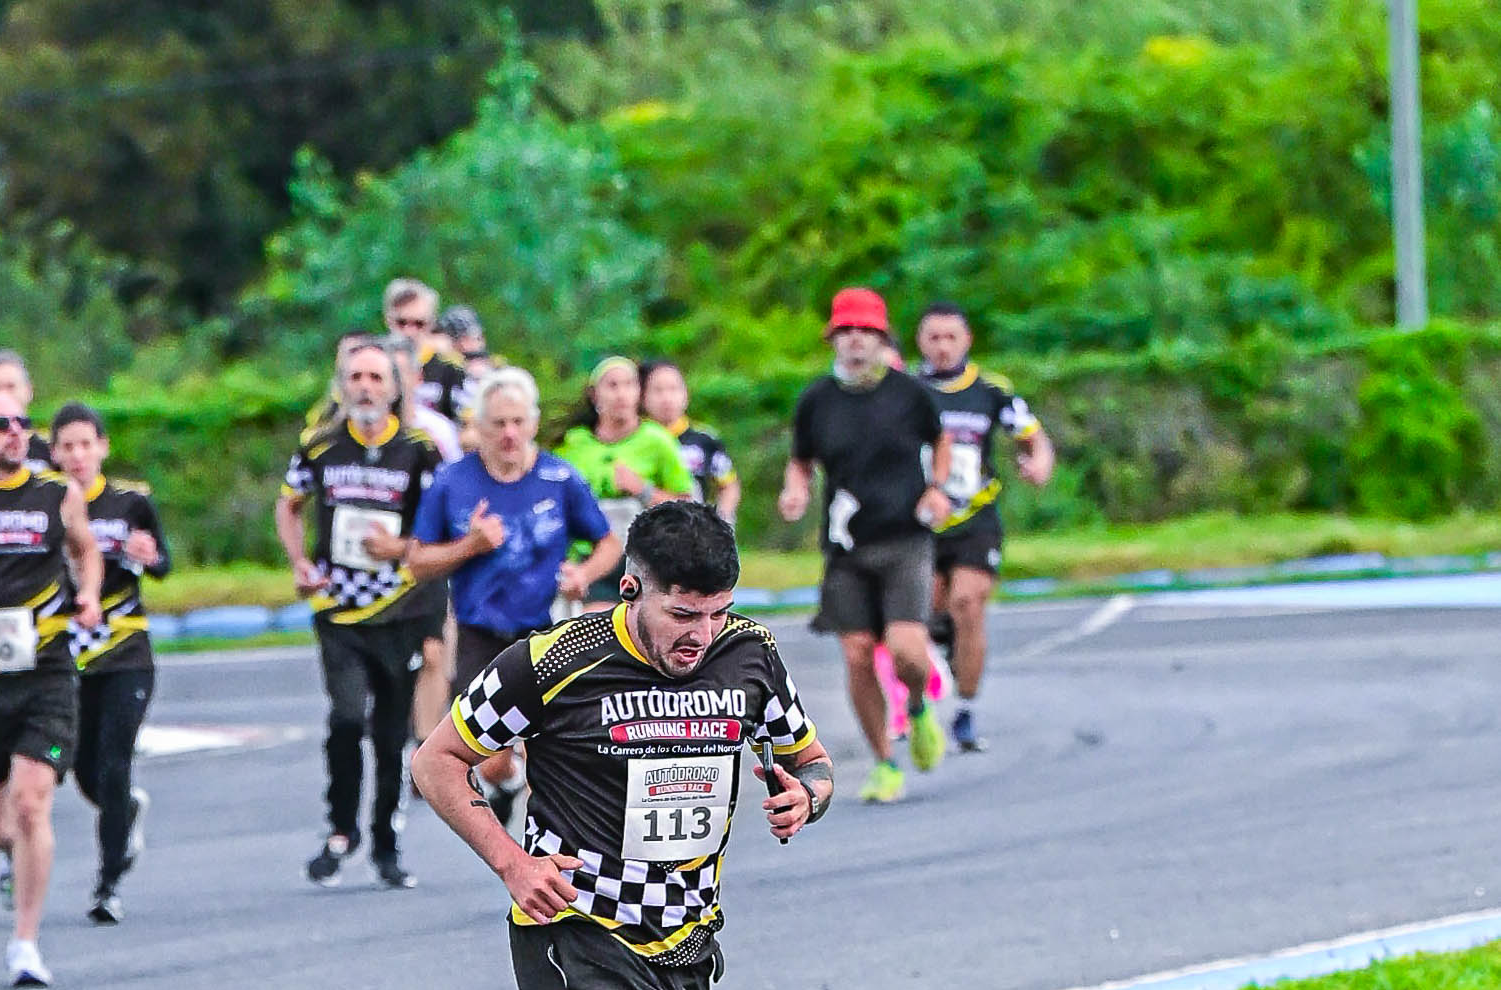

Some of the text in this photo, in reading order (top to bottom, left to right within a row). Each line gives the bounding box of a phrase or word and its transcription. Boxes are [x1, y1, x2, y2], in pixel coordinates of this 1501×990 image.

[601, 686, 747, 726] AUTÓDROMO
[625, 721, 728, 741] RUNNING RACE
[598, 744, 608, 755] La
[610, 745, 644, 756] Carrera
[644, 745, 656, 754] de
[657, 744, 669, 754] los
[671, 744, 701, 754] Clubes
[702, 743, 716, 754] del
[645, 763, 720, 786] AUTÓDROMO
[687, 783, 705, 793] RACE
[643, 806, 712, 842] 113
